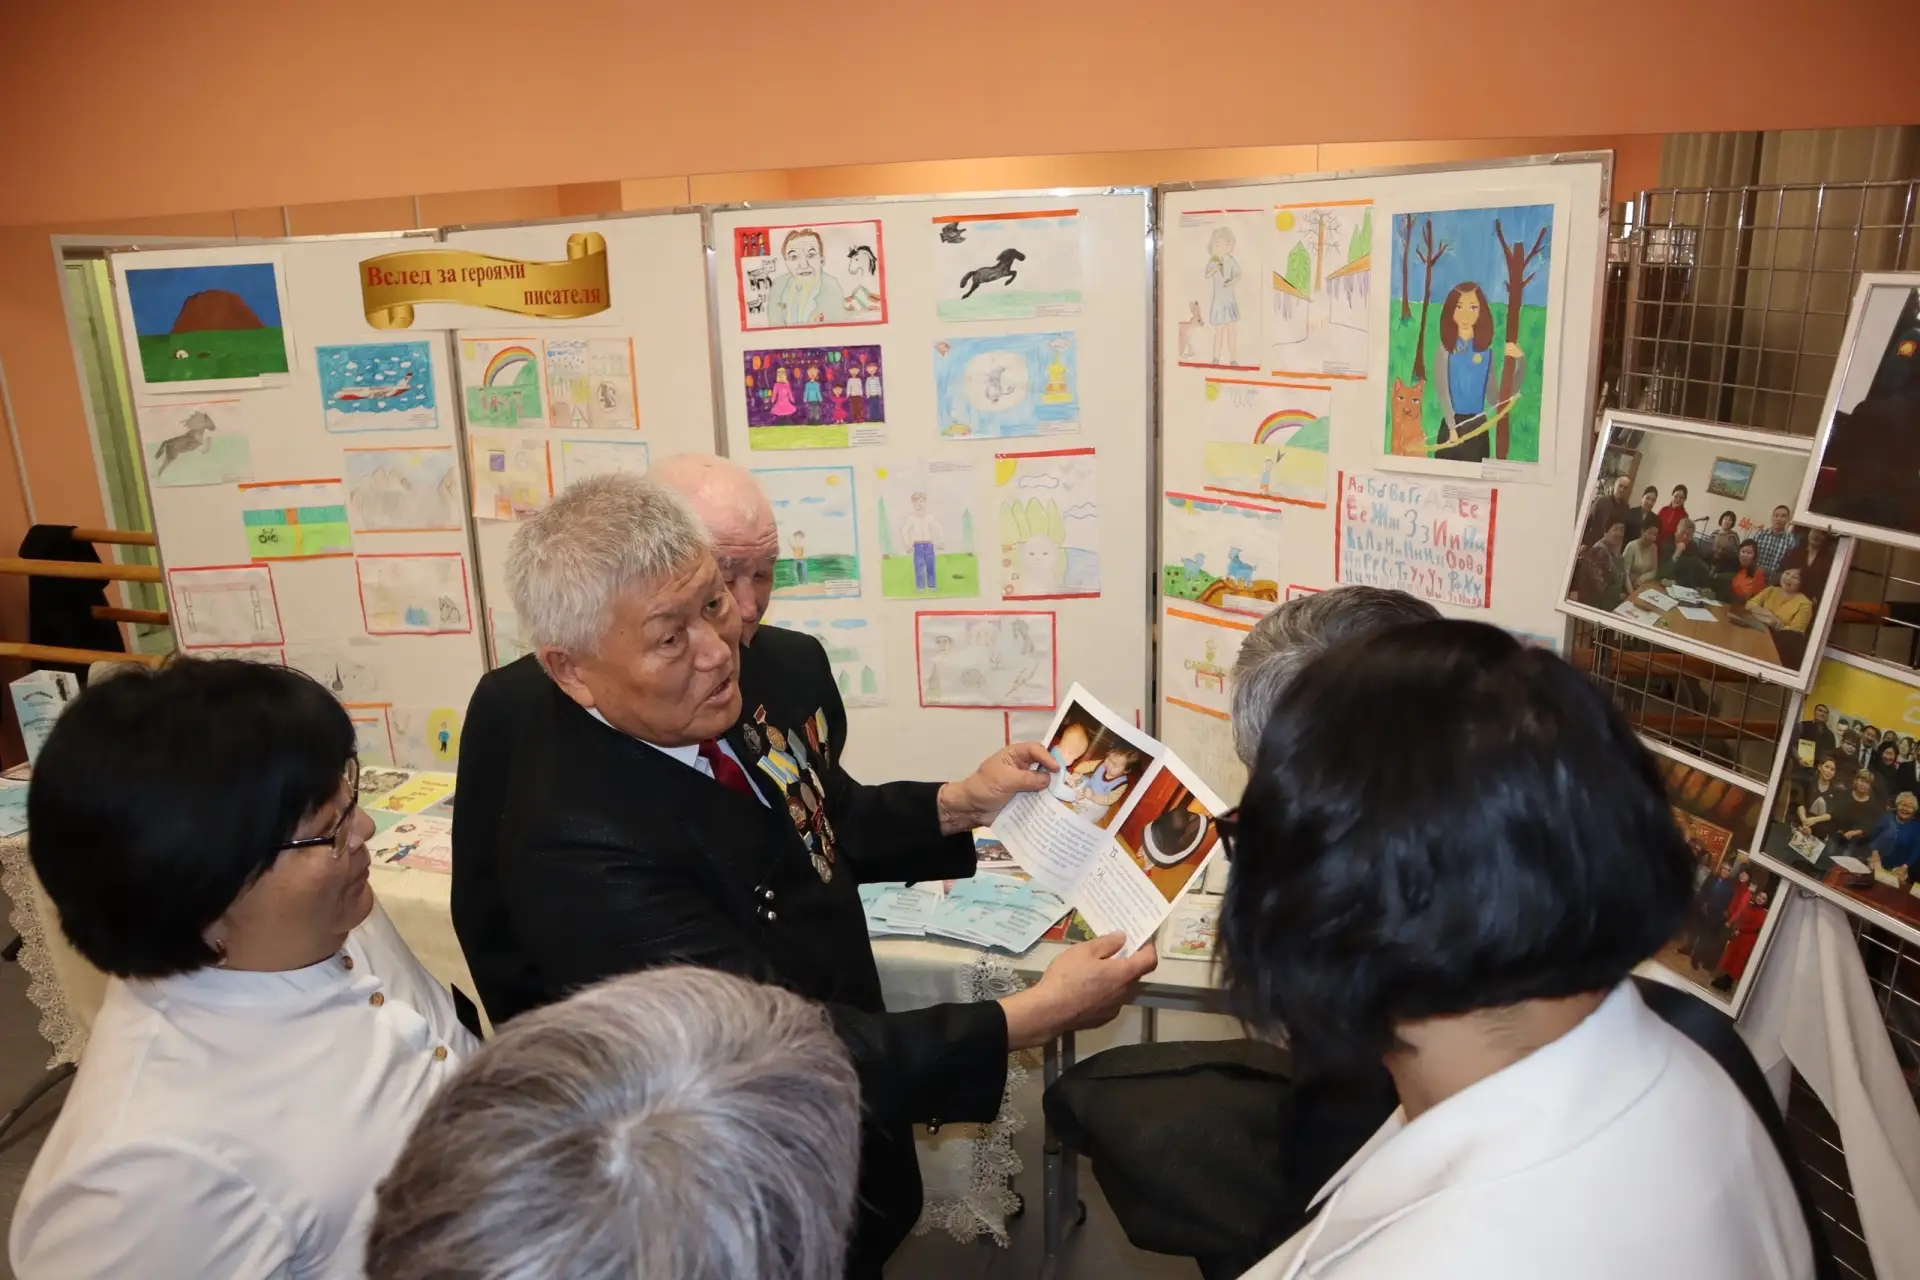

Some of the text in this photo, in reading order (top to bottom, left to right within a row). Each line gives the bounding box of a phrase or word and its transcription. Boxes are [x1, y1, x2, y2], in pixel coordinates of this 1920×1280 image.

[367, 263, 526, 287] Вслед за героями
[524, 288, 600, 306] писателя
